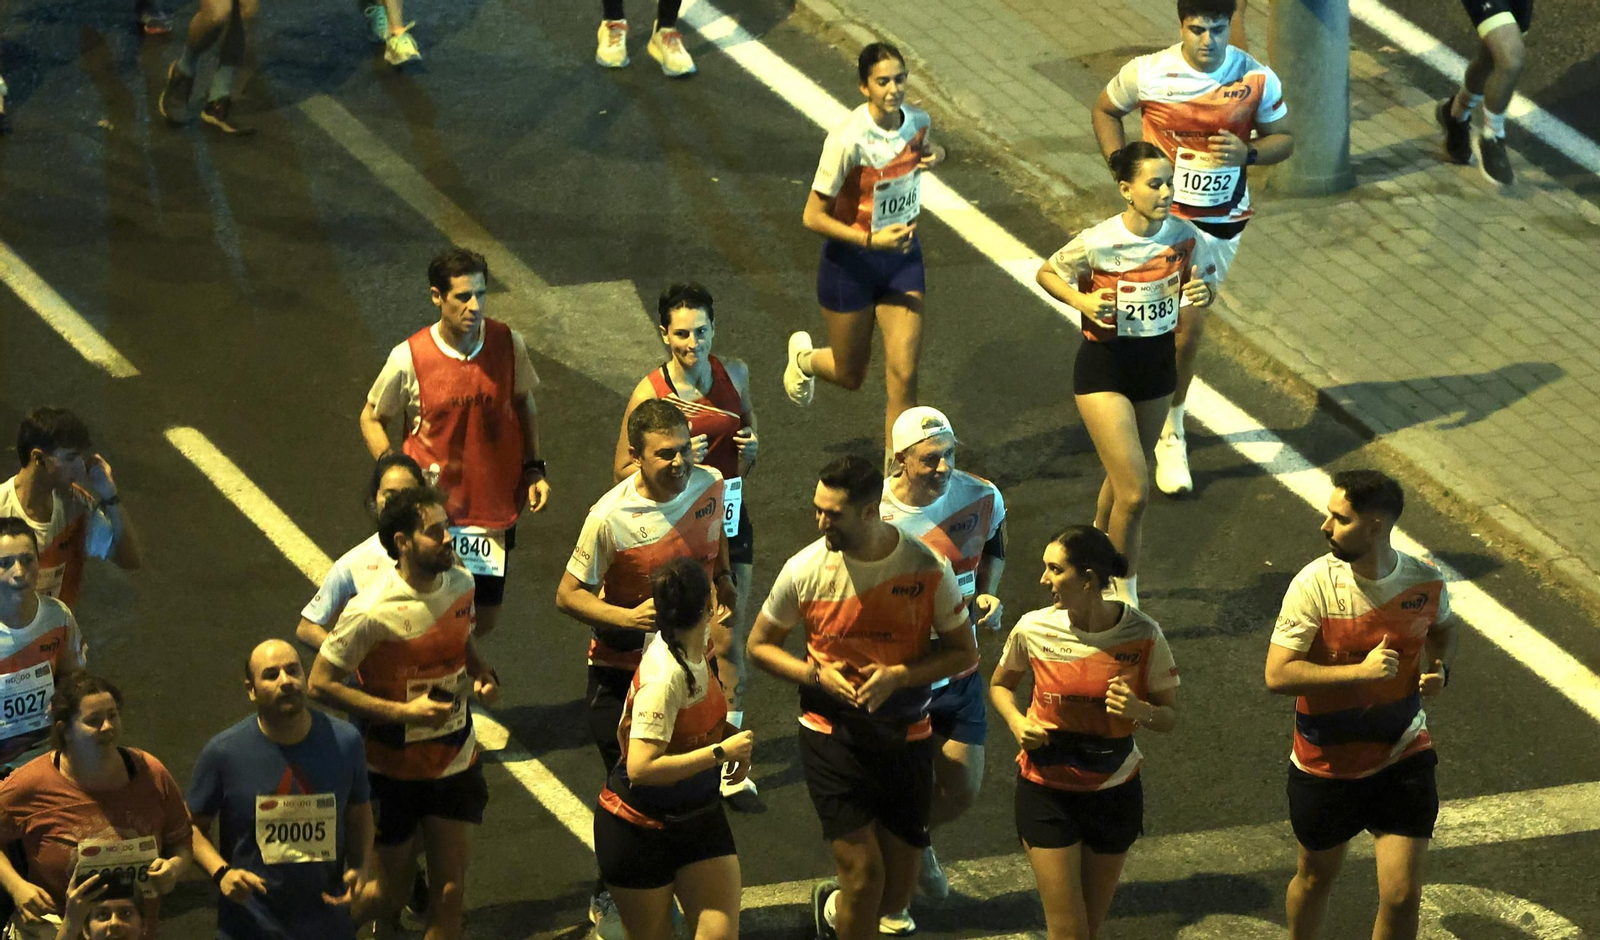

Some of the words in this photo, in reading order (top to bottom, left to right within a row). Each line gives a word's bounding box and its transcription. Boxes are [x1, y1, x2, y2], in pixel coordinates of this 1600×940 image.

[1182, 172, 1231, 192] 10252
[880, 188, 917, 215] 10246
[1125, 298, 1174, 321] 21383
[452, 536, 491, 557] 1840
[4, 690, 47, 719] 5027
[265, 820, 326, 844] 20005
